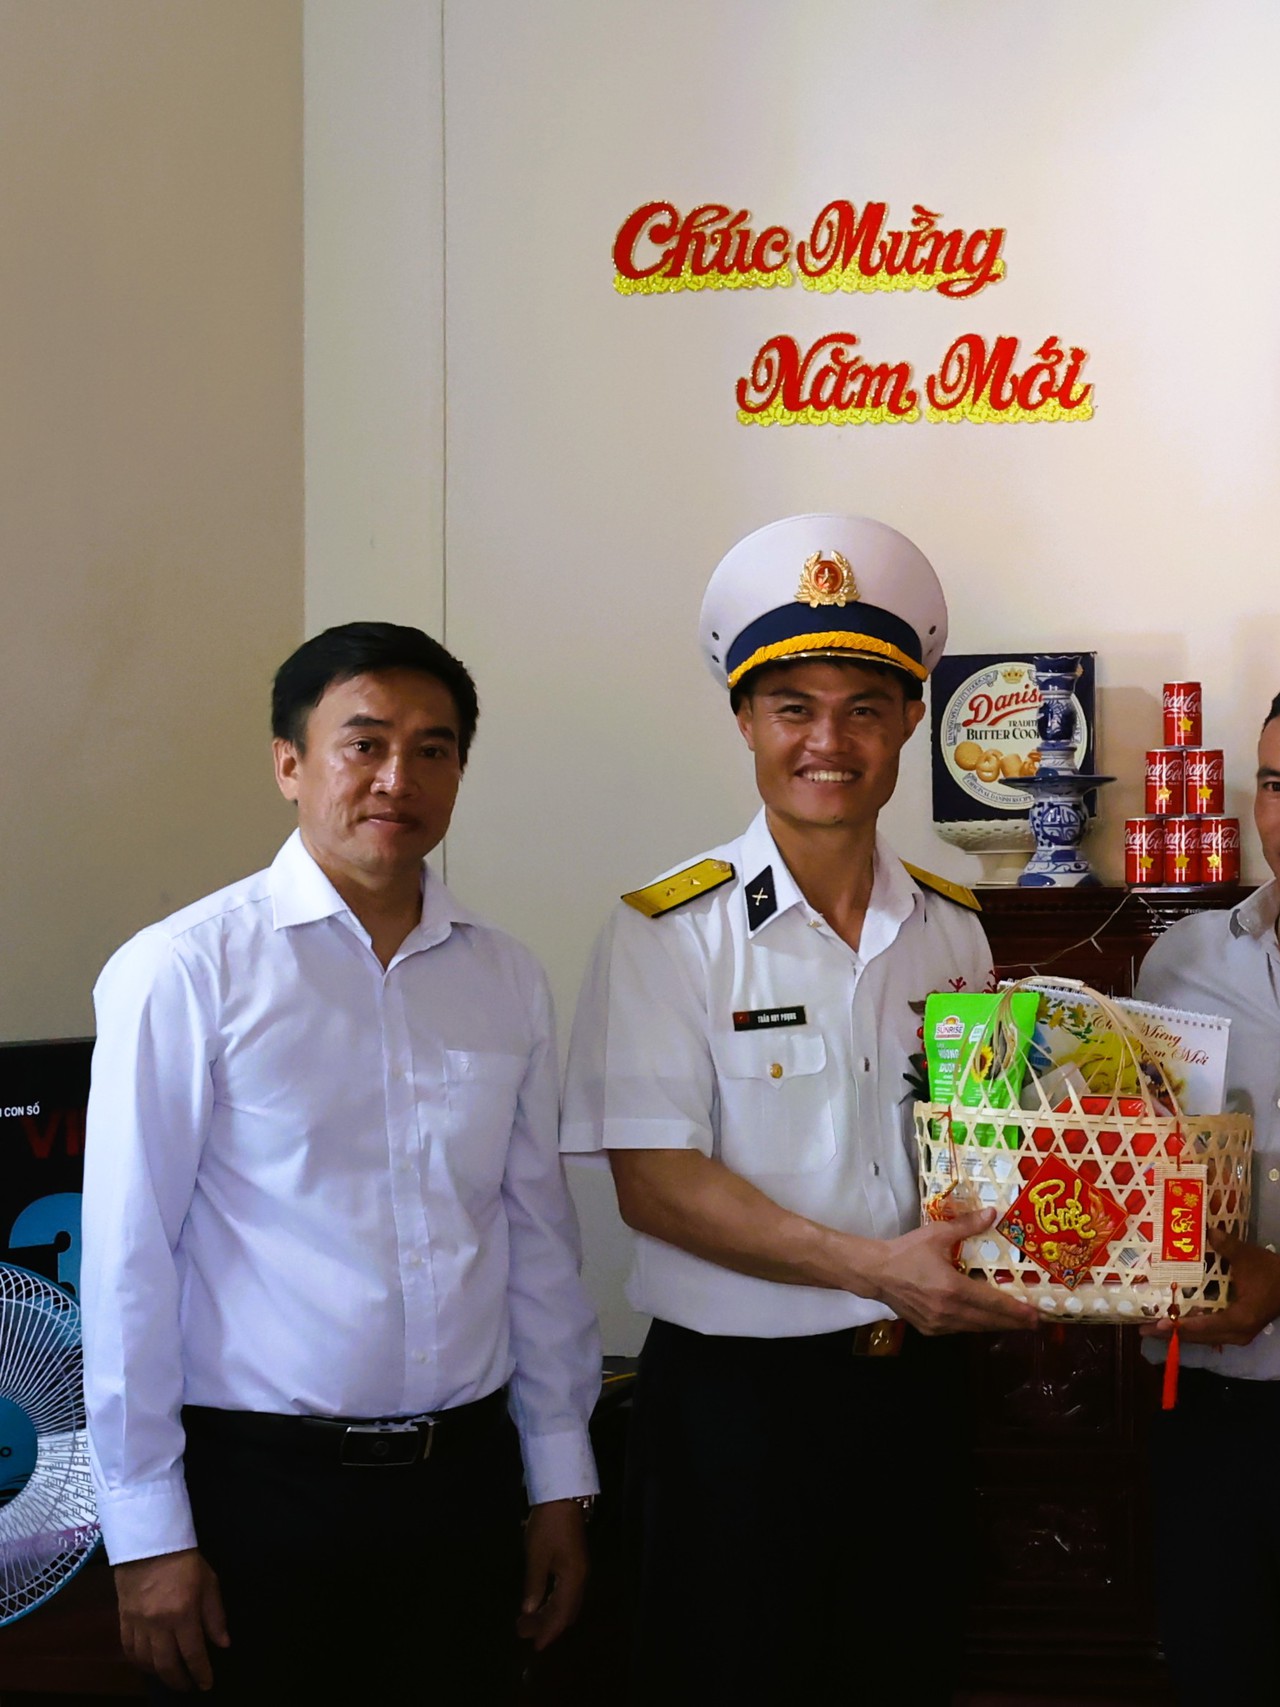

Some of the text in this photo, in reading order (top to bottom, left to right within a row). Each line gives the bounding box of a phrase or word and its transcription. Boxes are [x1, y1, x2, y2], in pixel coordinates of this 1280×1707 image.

[612, 200, 1004, 299] Chúc Mừng
[736, 332, 1091, 414] Năm Mới
[967, 728, 1010, 740] BUTTER
[4, 1106, 24, 1118] CON
[26, 1101, 40, 1116] SỐ
